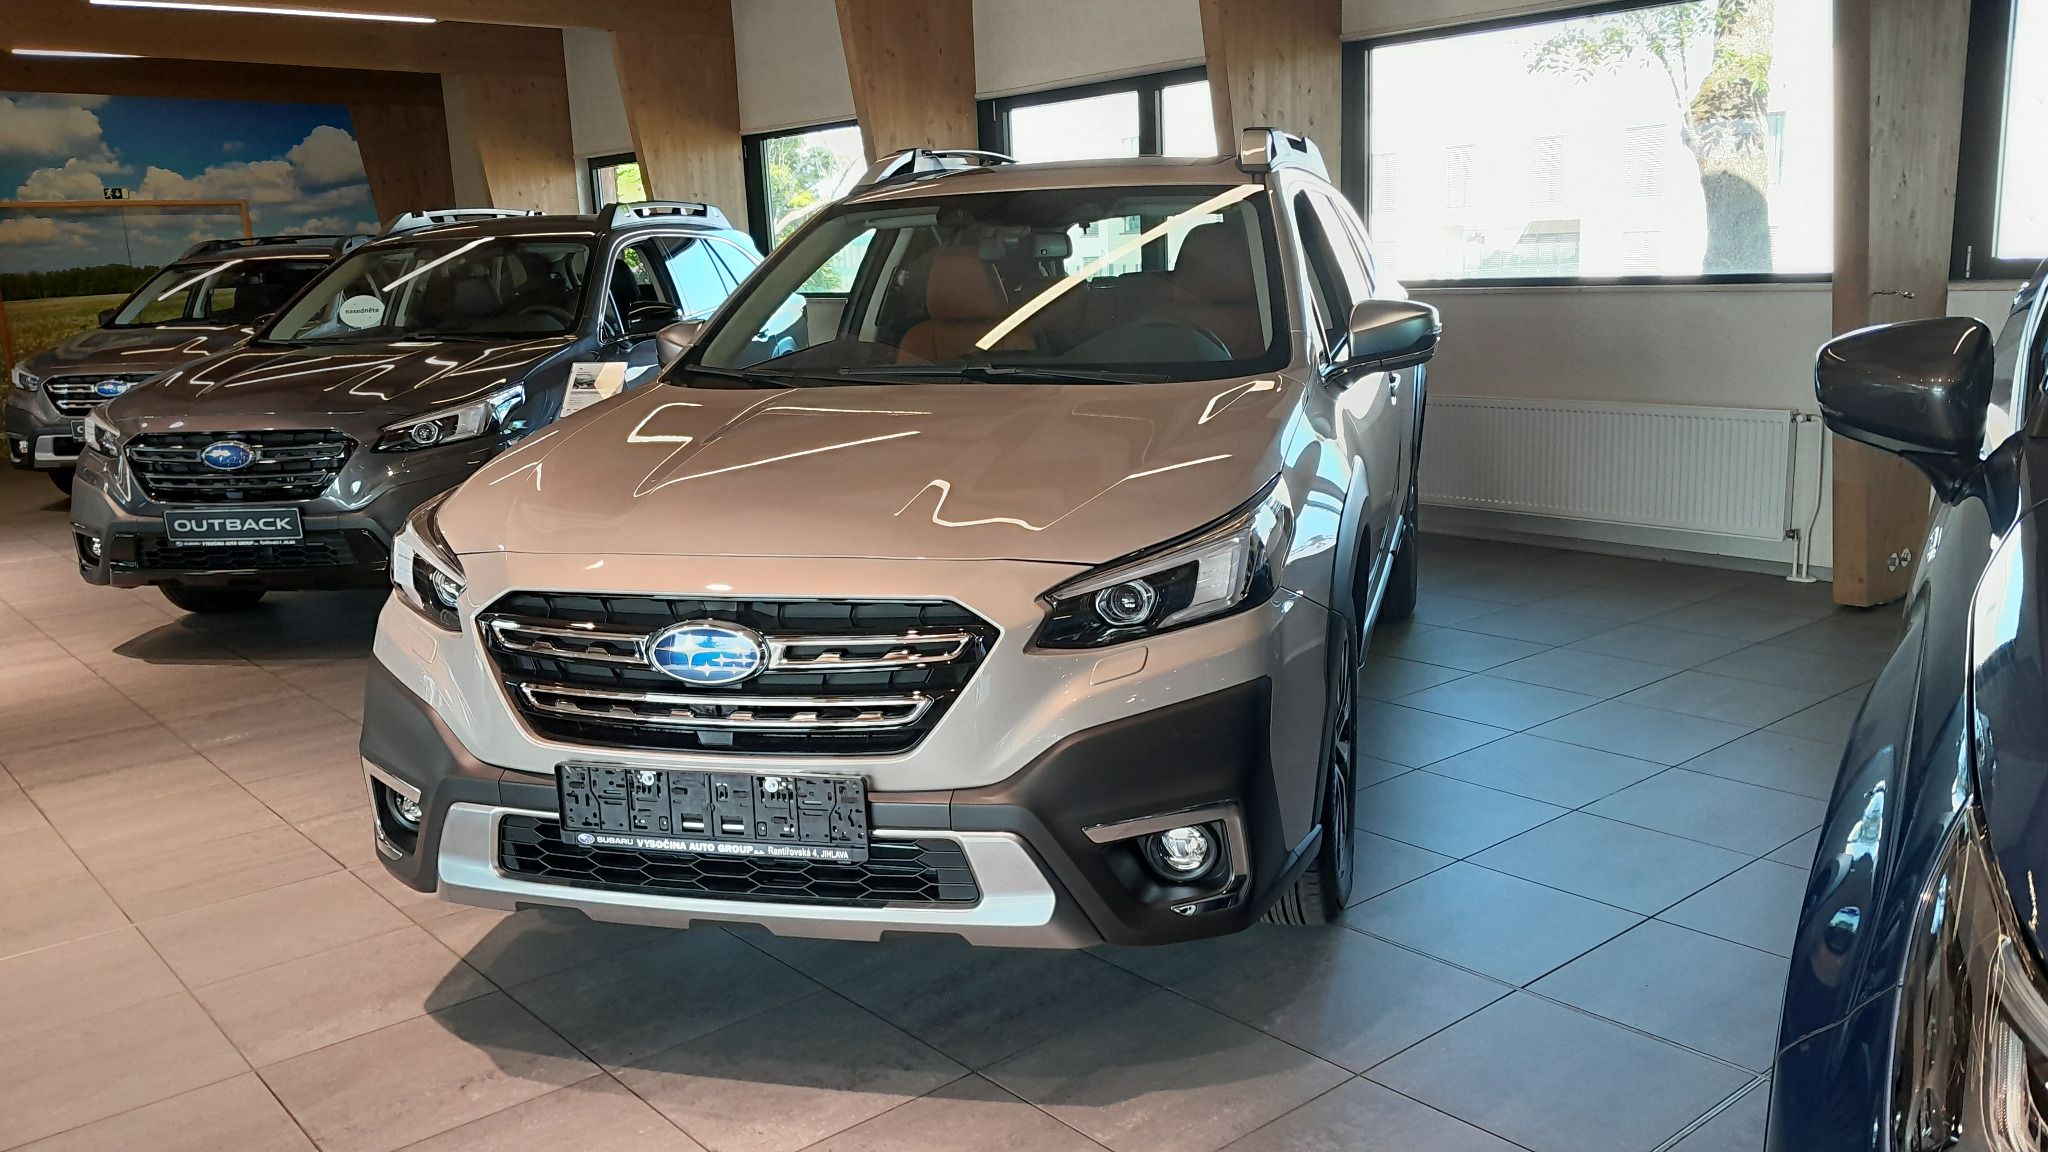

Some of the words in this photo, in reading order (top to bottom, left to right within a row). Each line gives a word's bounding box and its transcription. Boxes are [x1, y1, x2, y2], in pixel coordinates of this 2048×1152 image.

[173, 518, 292, 532] OUTBACK
[596, 836, 634, 845] SUBARU
[636, 838, 687, 850] VYSOČINA
[689, 842, 715, 852] AUTO
[717, 844, 753, 854] GROUP
[820, 850, 849, 859] JIHLAVA
